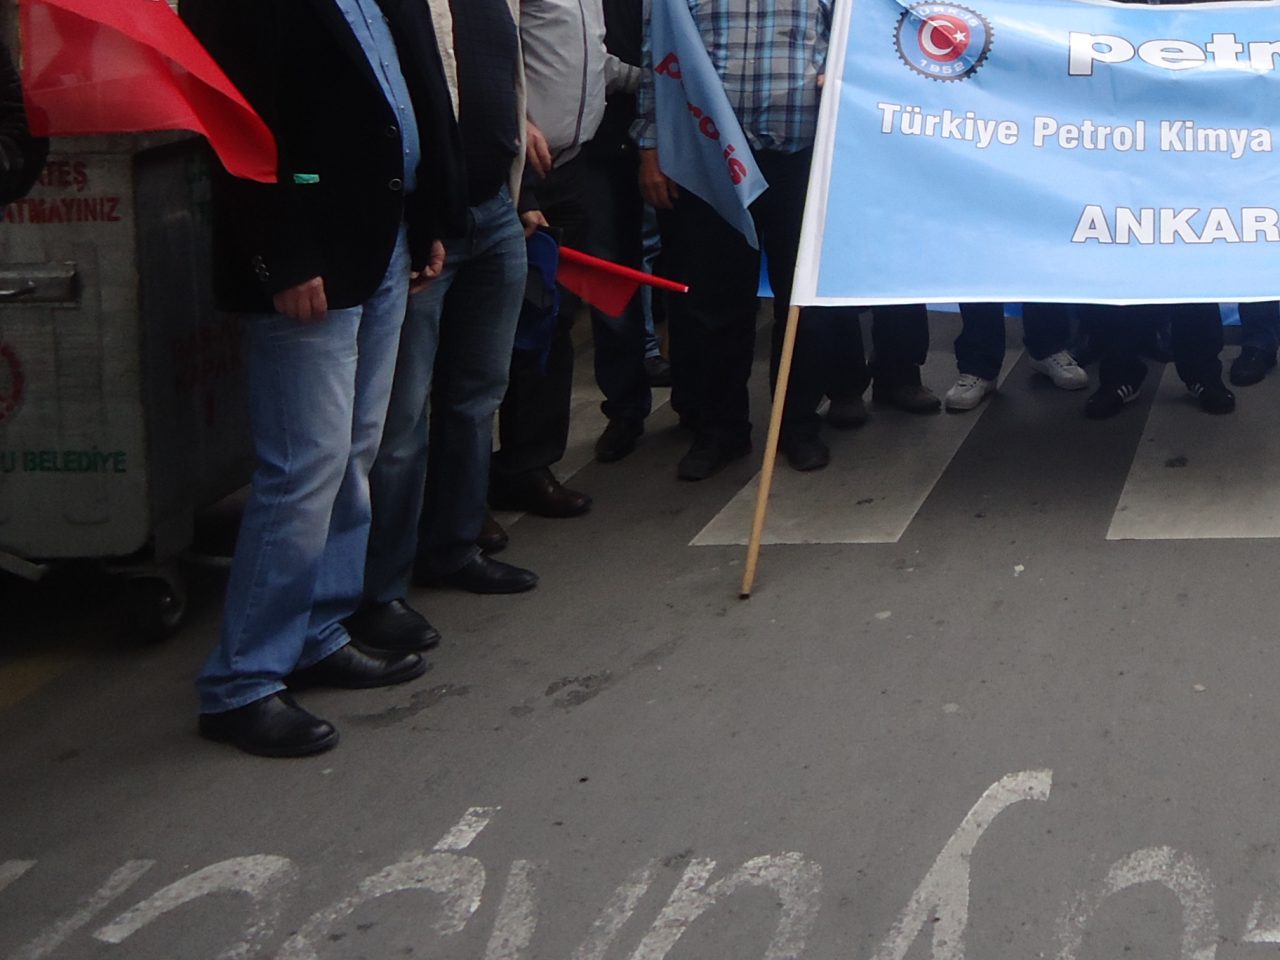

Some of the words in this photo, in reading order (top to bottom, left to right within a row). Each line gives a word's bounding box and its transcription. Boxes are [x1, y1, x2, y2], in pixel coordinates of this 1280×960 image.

[919, 58, 966, 75] 1952
[877, 102, 1019, 150] Türkiye
[1033, 116, 1146, 153] Petrol
[1159, 120, 1274, 160] Kimya
[38, 160, 89, 193] TEŞ
